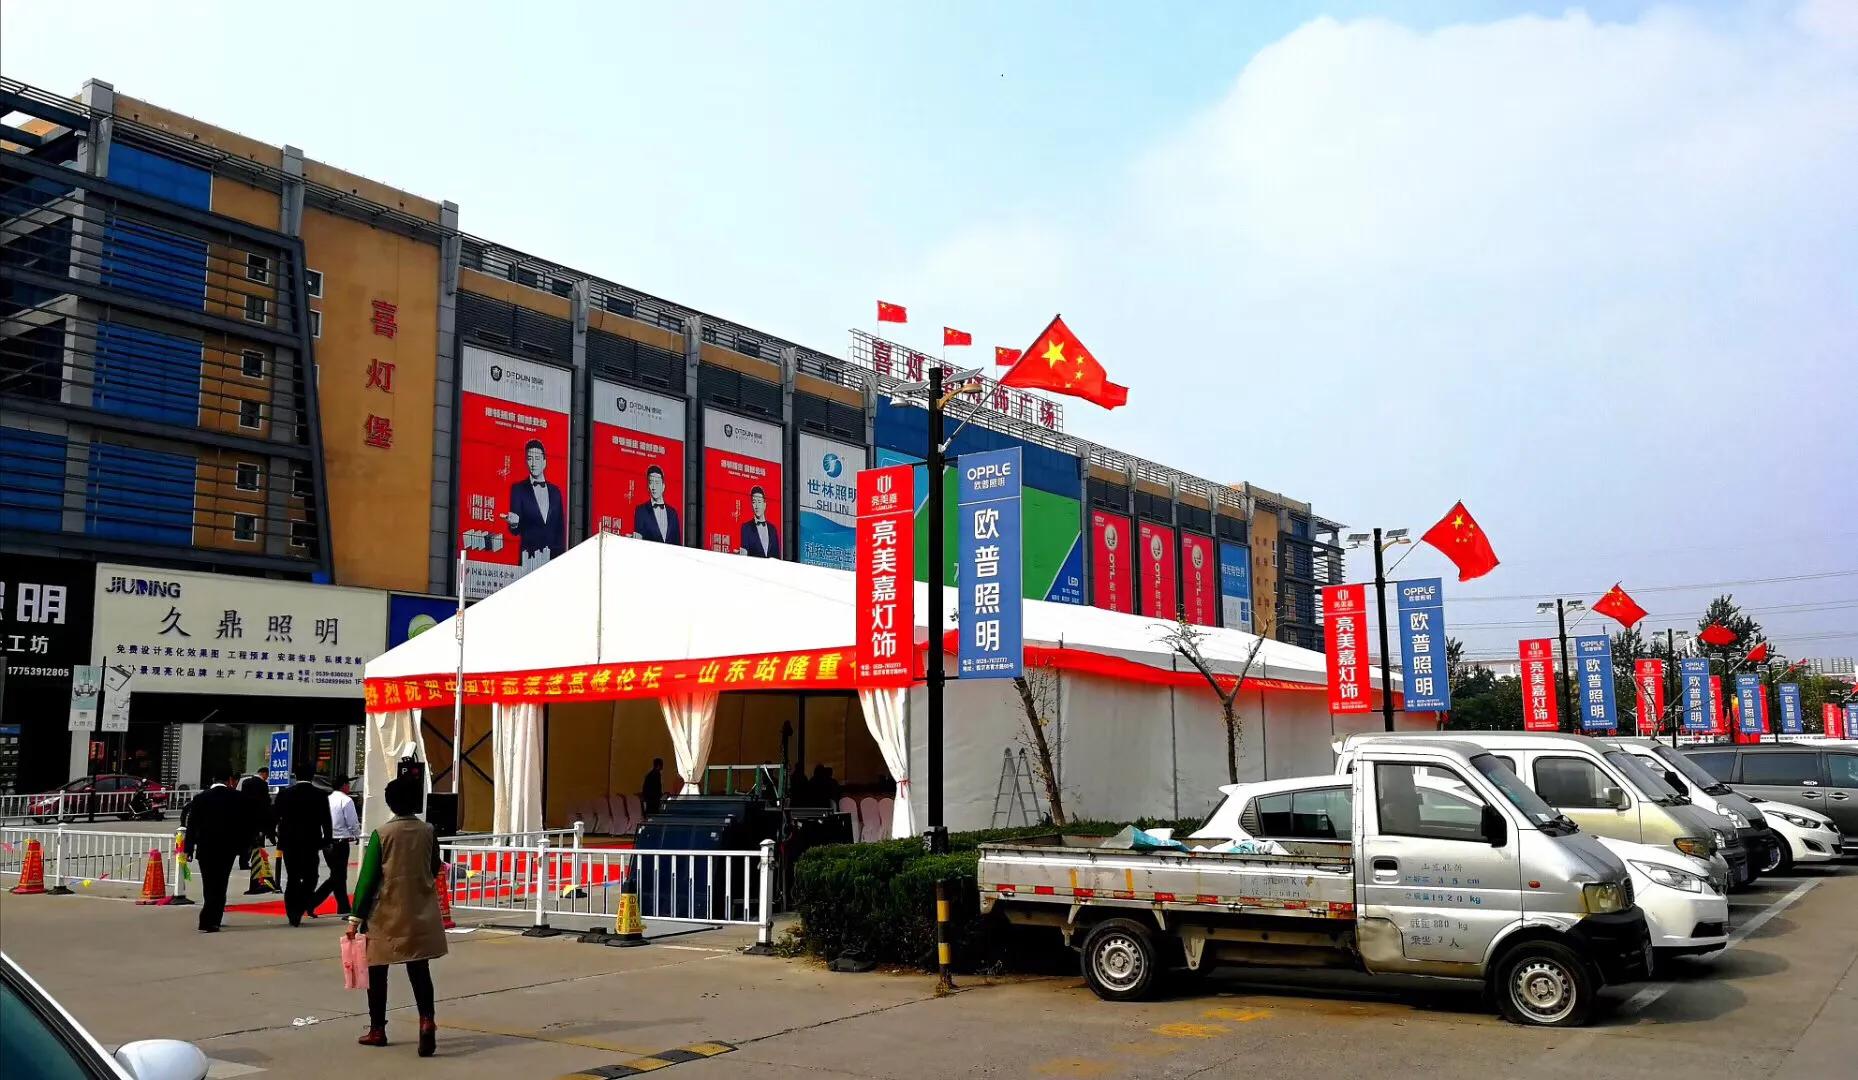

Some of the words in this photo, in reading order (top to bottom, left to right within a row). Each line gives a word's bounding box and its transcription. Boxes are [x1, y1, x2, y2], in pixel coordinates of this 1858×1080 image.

[365, 300, 397, 449] 喜灯堡
[967, 462, 1012, 482] OPPLE
[816, 499, 833, 511] SHI
[833, 503, 849, 515] LIN
[871, 519, 897, 659] 亮美嘉灯饰
[974, 508, 1000, 652] 欧普照明
[1403, 586, 1436, 596] OPPLE
[157, 605, 339, 645] 久鼎照明
[0, 634, 50, 654] 工坊
[116, 644, 219, 658] 免费设计亮化效果图
[228, 650, 269, 660] 工程预算
[277, 652, 316, 662] 安装指导
[1410, 612, 1434, 696] 欧普照明
[1336, 616, 1358, 699] 亮美嘉灯饰
[7, 666, 69, 677] 17753912805
[117, 664, 208, 677] 景观亮化品牌
[1530, 661, 1549, 721] 亮美嘉灯饰
[1586, 658, 1605, 719] 欧普照明
[272, 739, 288, 753] 入口
[1469, 894, 1481, 904] kg
